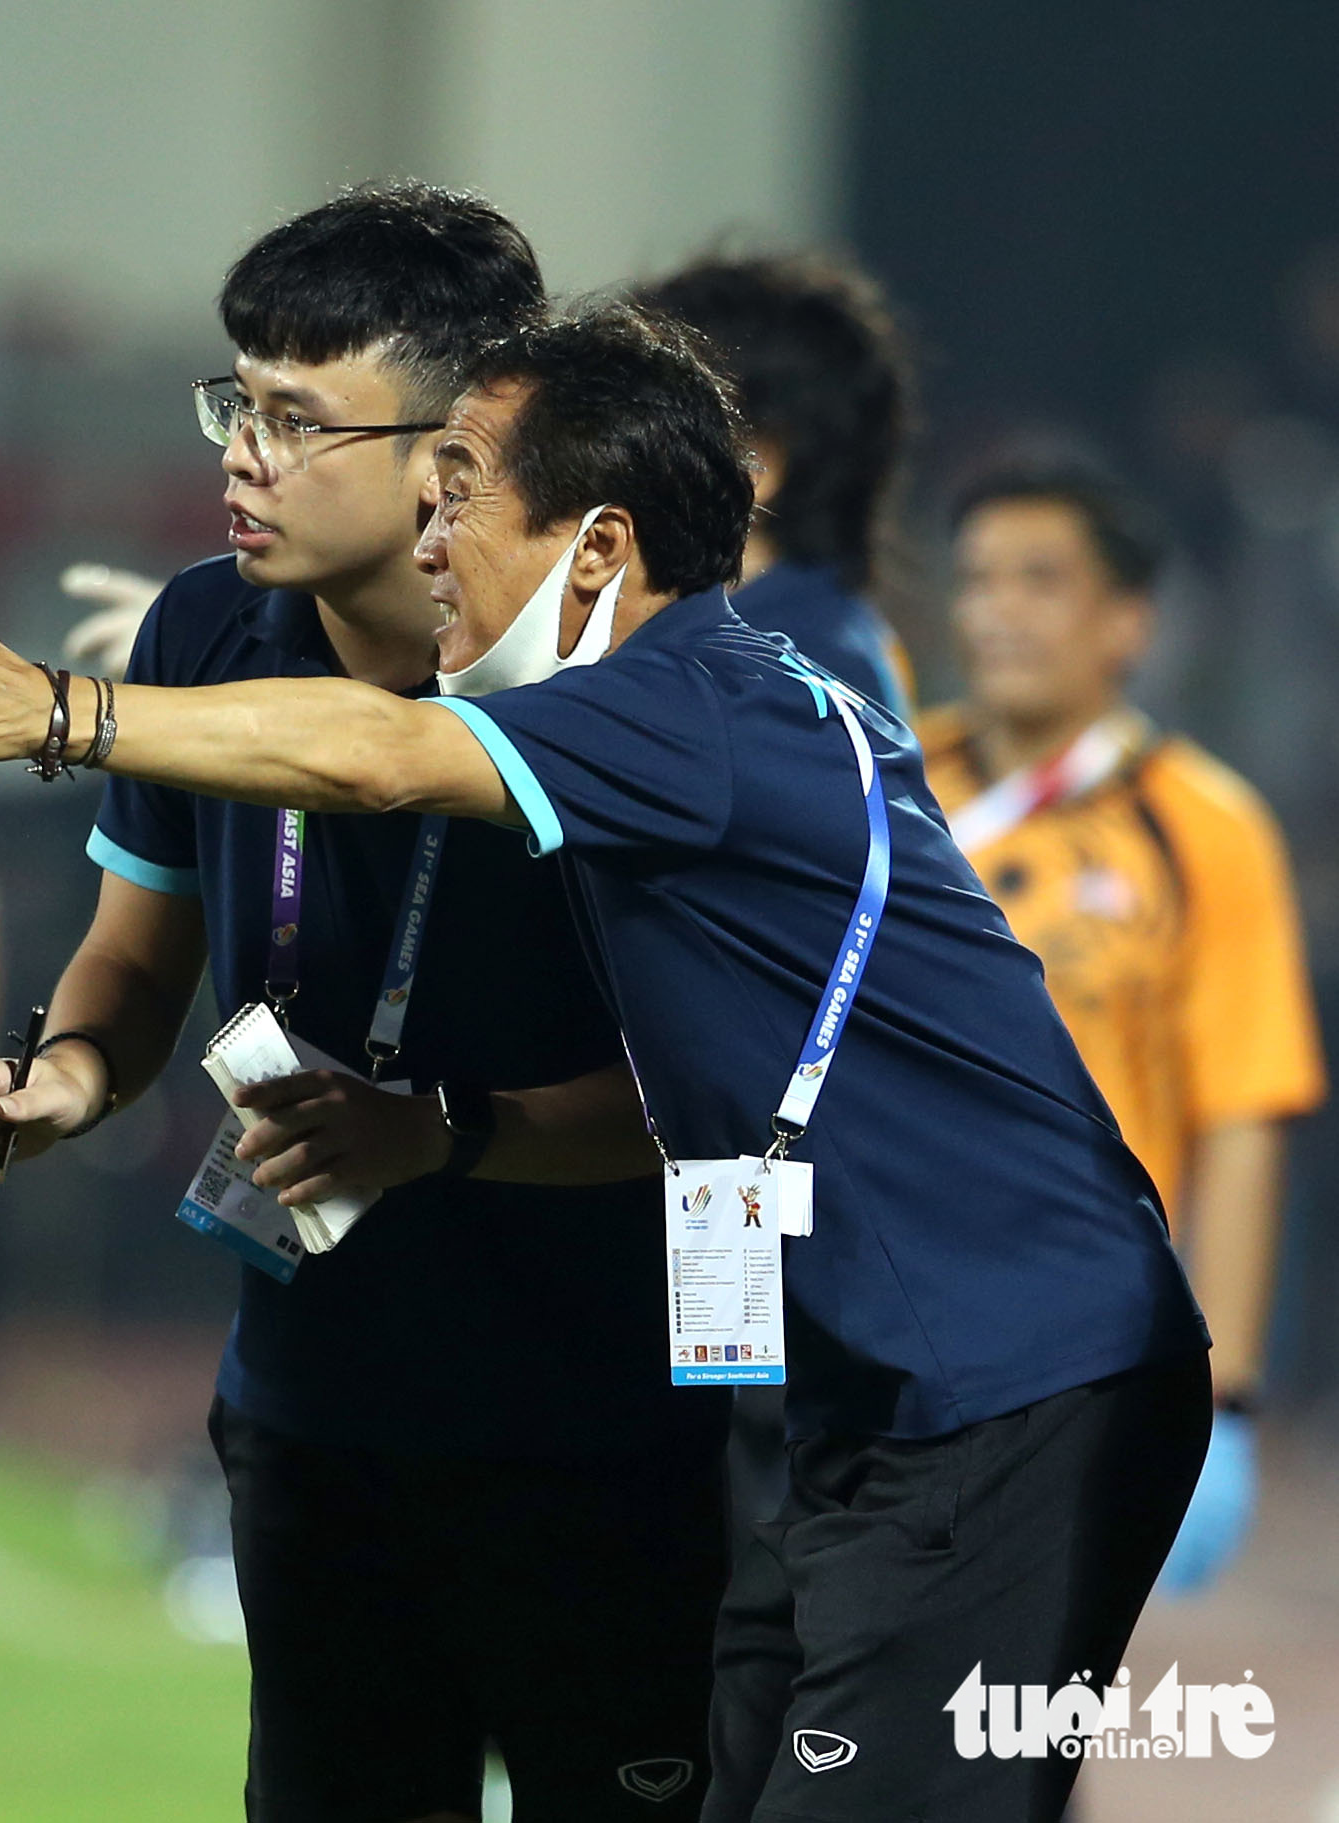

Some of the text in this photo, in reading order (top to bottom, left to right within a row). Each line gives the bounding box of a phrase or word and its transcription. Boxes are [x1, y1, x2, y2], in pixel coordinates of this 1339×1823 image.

[280, 852, 296, 898] ASIA
[412, 872, 430, 905] SEA
[398, 910, 421, 972] GAMES
[838, 949, 860, 984] SEA
[816, 987, 847, 1050] GAMES
